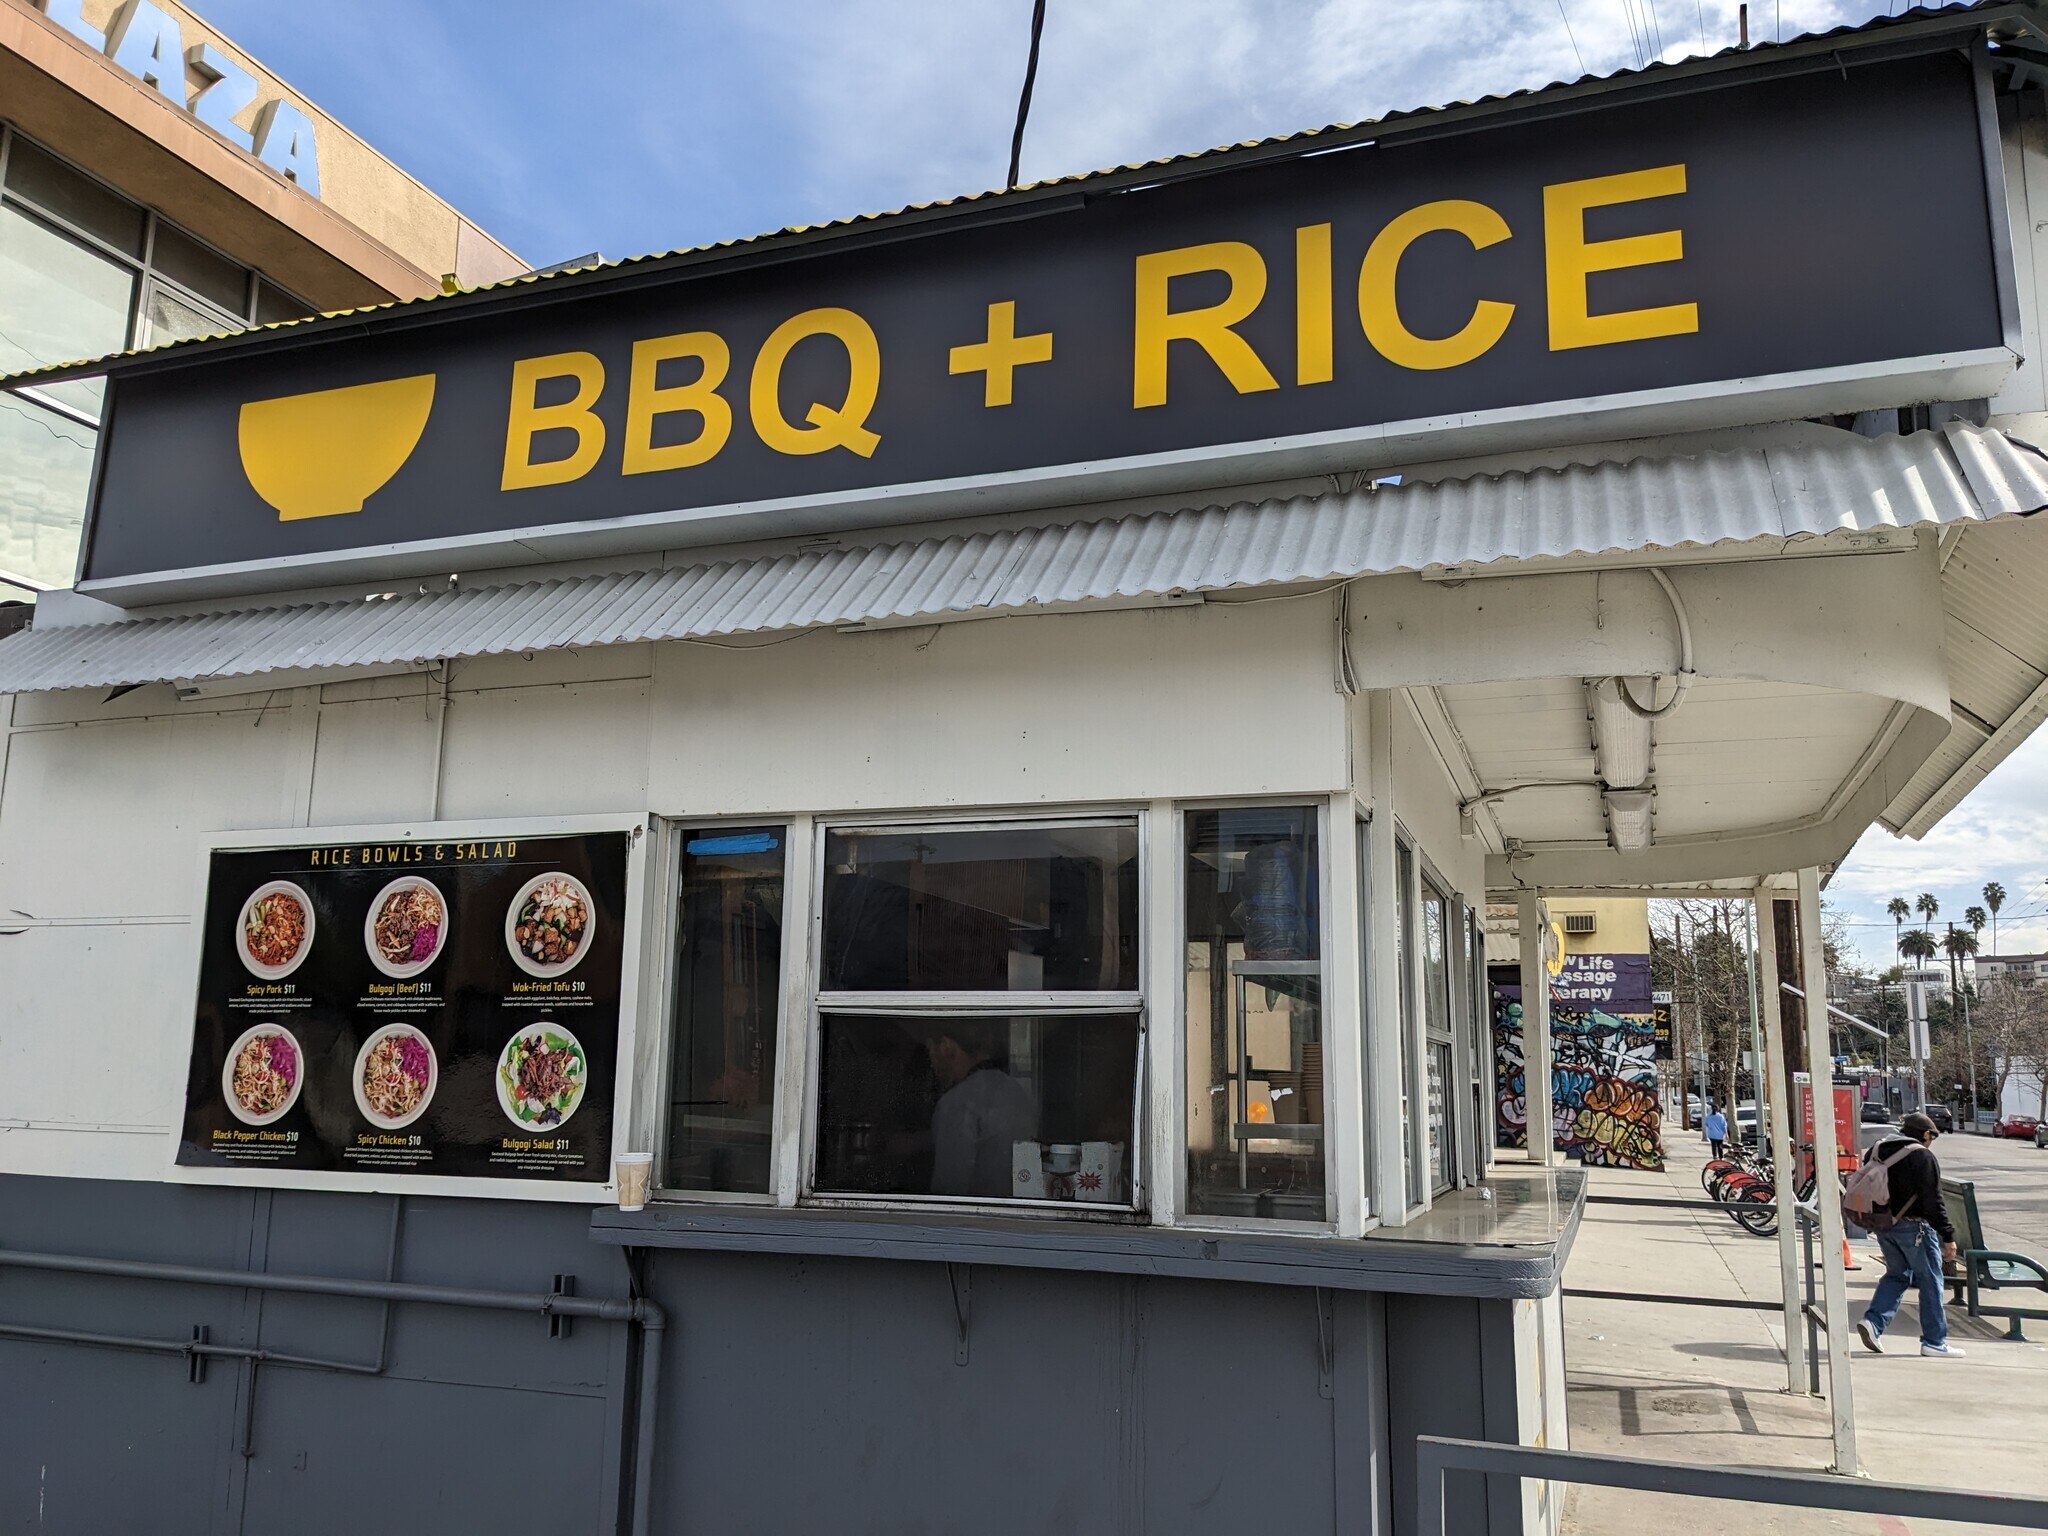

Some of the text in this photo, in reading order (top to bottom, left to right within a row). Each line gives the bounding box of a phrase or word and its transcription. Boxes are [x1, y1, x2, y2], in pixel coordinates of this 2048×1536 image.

[500, 306, 883, 492] BBQ
[1133, 163, 1699, 409] RICE
[311, 841, 517, 865] RICE BOWLS & SALAD
[1578, 956, 1614, 970] Life
[1562, 971, 1617, 985] ssage
[246, 983, 296, 996] Spicy Pork $11
[369, 983, 396, 995] Bulgogi
[419, 982, 432, 994] $11
[512, 980, 586, 992] Wok-Fried Tofu $10
[212, 1129, 299, 1142] Black Pepper Chicken $10
[357, 1133, 422, 1146] Spicy Chicken $10
[502, 1138, 569, 1151] Bulgogi Salad $11
